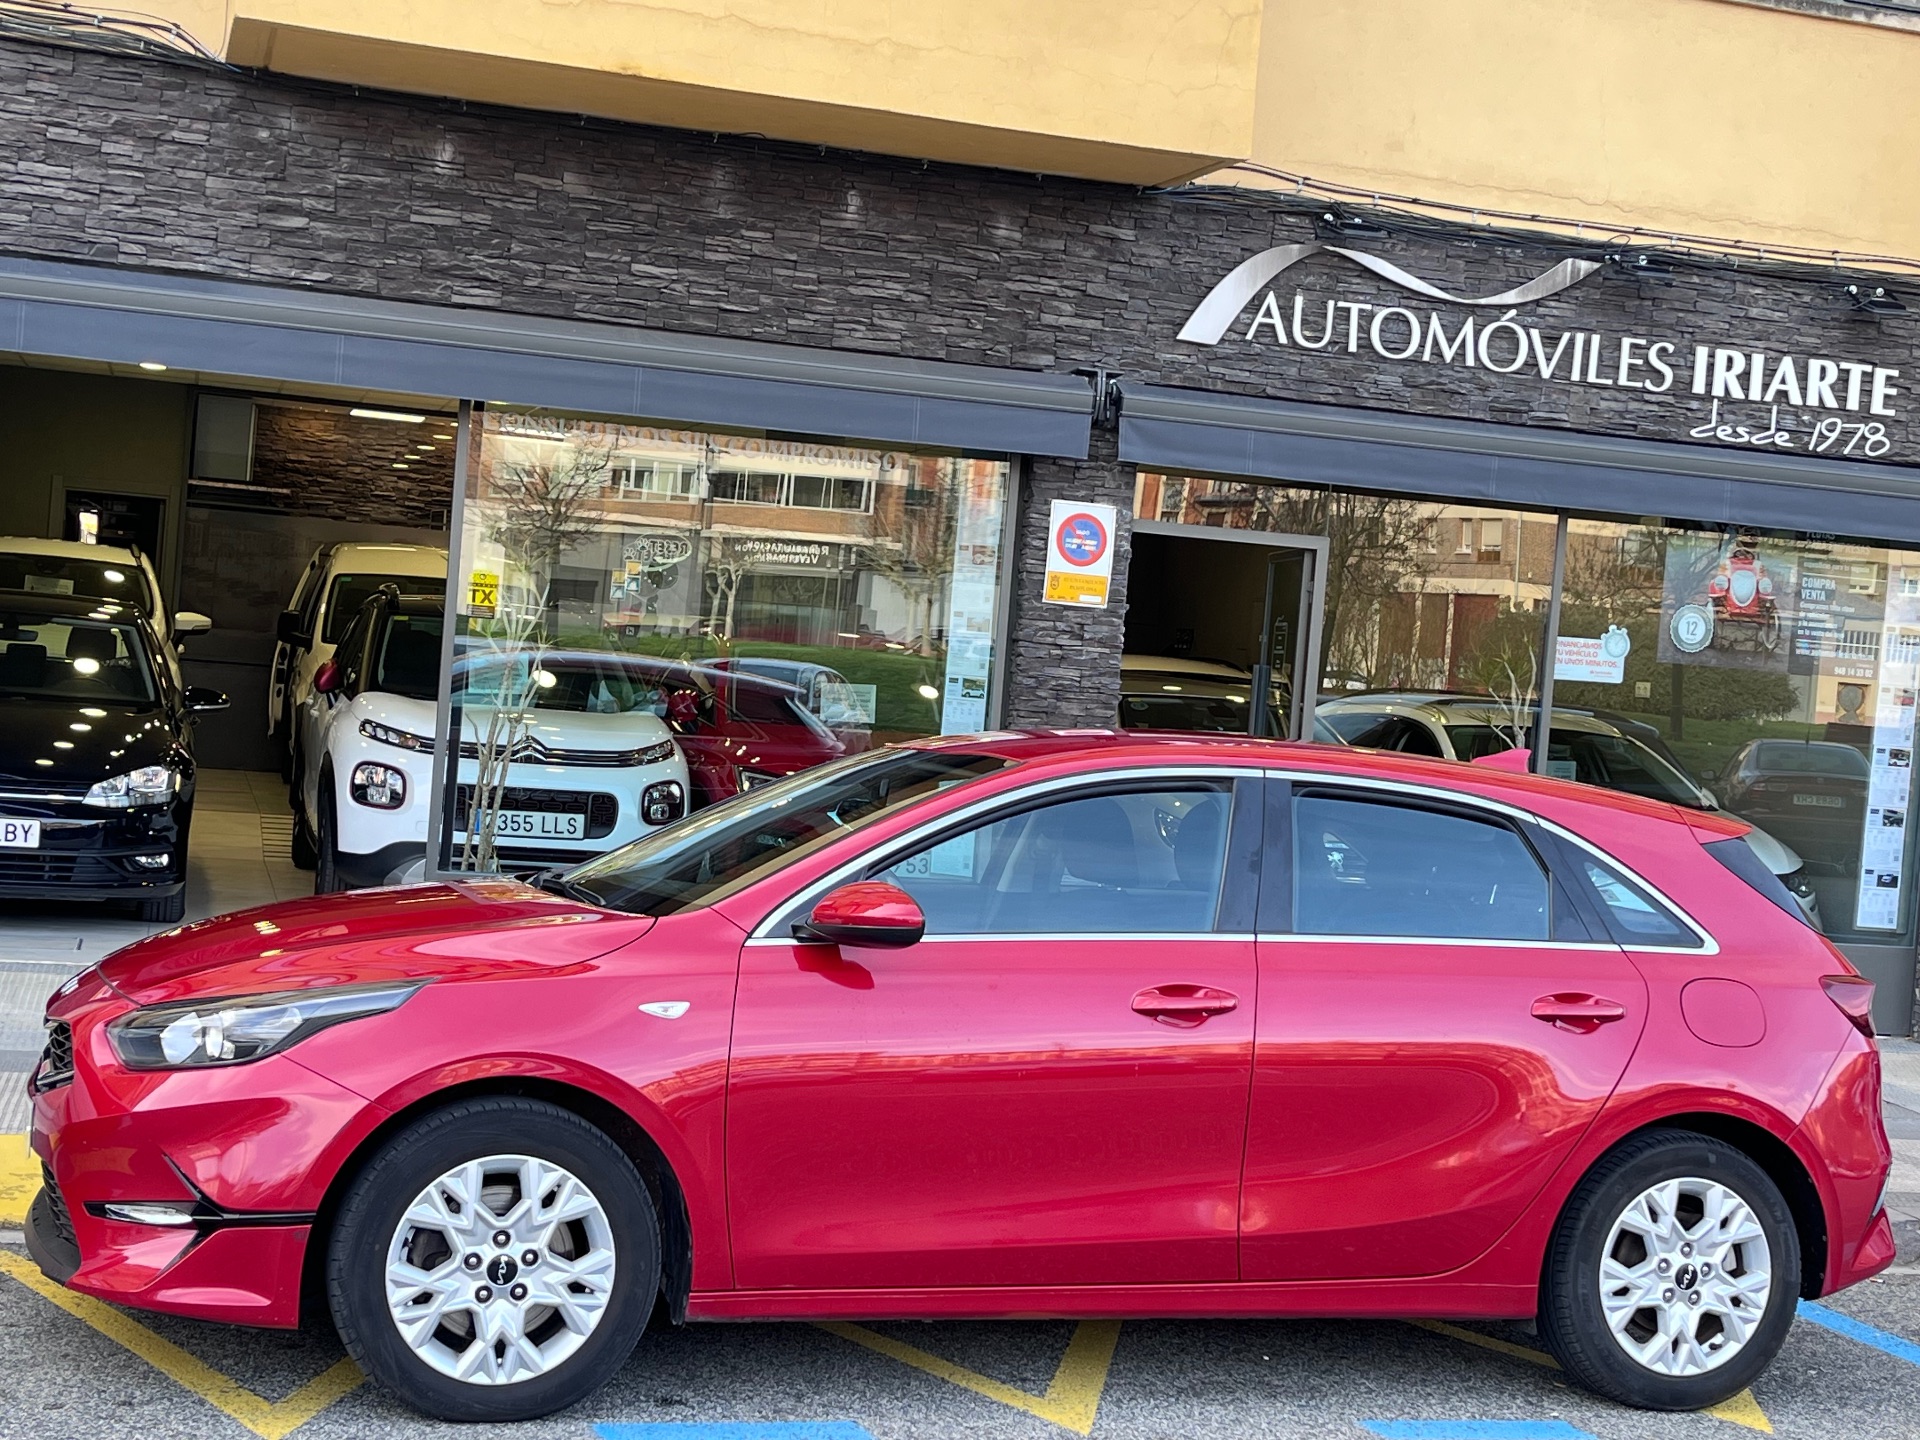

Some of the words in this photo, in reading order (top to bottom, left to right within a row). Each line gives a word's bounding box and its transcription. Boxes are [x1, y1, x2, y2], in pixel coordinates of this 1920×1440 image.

[1245, 290, 1675, 393] AUTOMÓVILES
[1691, 346, 1900, 417] IRIARTE
[1690, 398, 1795, 447] desde
[1808, 417, 1891, 456] 1978
[1802, 577, 1836, 591] COMPRA
[1801, 588, 1826, 601] VENTA
[1685, 620, 1698, 636] 12
[1834, 666, 1846, 675] 948
[1847, 667, 1855, 676] 14
[0, 823, 33, 843] BY
[541, 815, 577, 835] LLS
